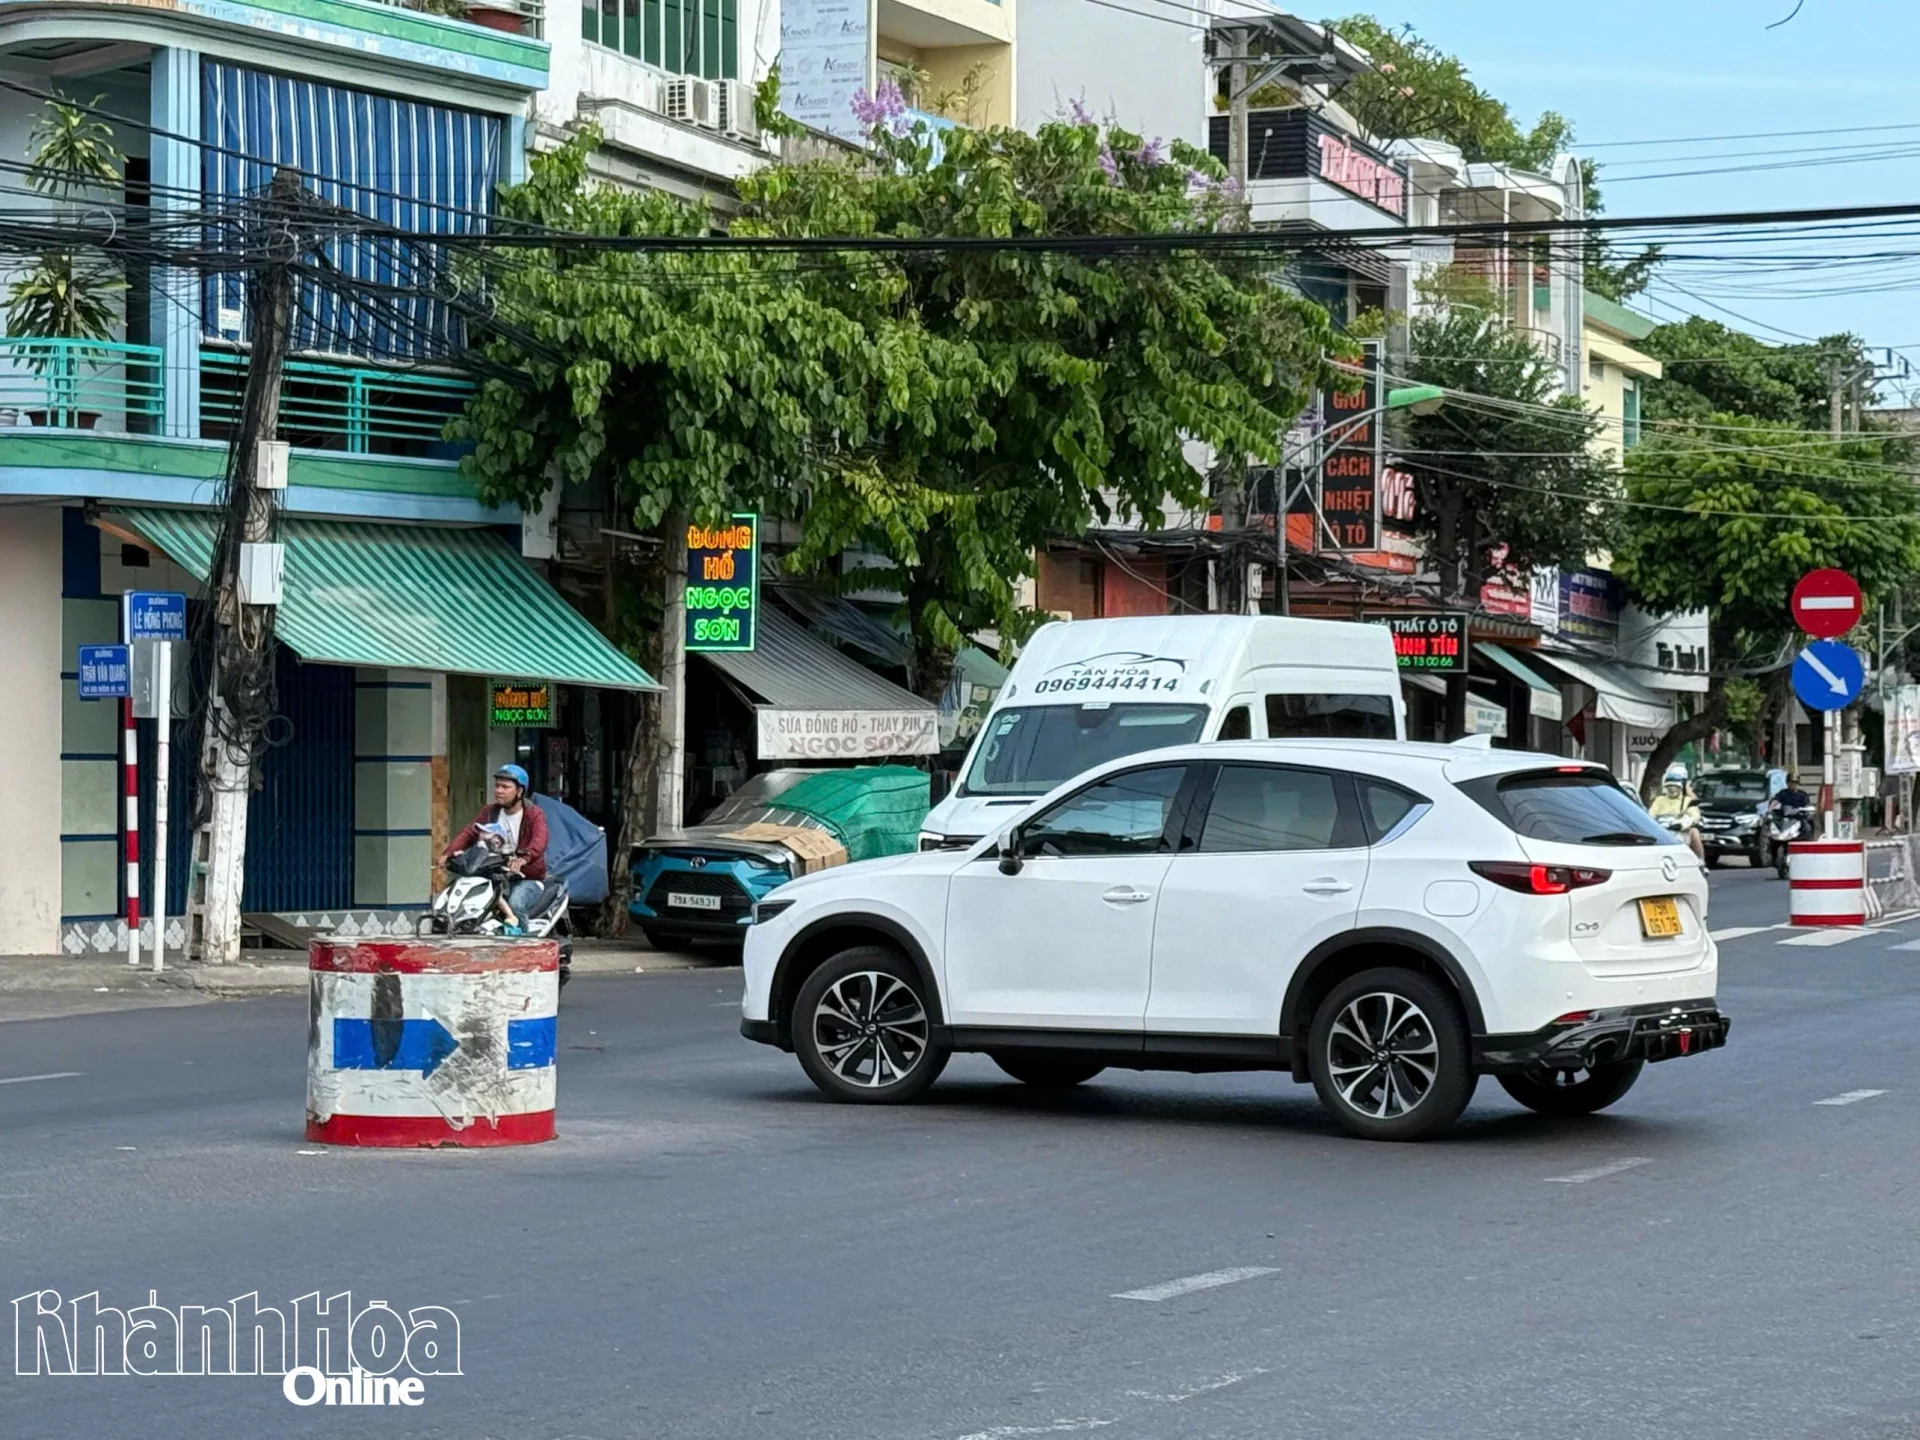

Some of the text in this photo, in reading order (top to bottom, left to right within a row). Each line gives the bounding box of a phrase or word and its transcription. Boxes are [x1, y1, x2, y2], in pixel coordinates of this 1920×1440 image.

[1326, 454, 1370, 476] CÁCH
[1325, 490, 1372, 515] NHIỆT
[1346, 521, 1366, 545] TÔ
[703, 549, 734, 580] HỒ
[686, 586, 750, 615] NGỌC
[134, 607, 142, 629] LÊ
[694, 617, 740, 641] SƠN
[1393, 616, 1426, 633] THẤT
[1428, 618, 1439, 633] Ô
[1440, 618, 1458, 633] TÔ
[1035, 677, 1178, 693] 0969444414
[495, 709, 524, 723] NGỌC
[779, 714, 802, 733] SỬA
[806, 713, 837, 733] ĐỒNG
[841, 712, 858, 733] HỒ
[870, 716, 899, 733] THAY
[902, 716, 921, 732] PIN
[787, 733, 914, 756] NGỌC SƠN
